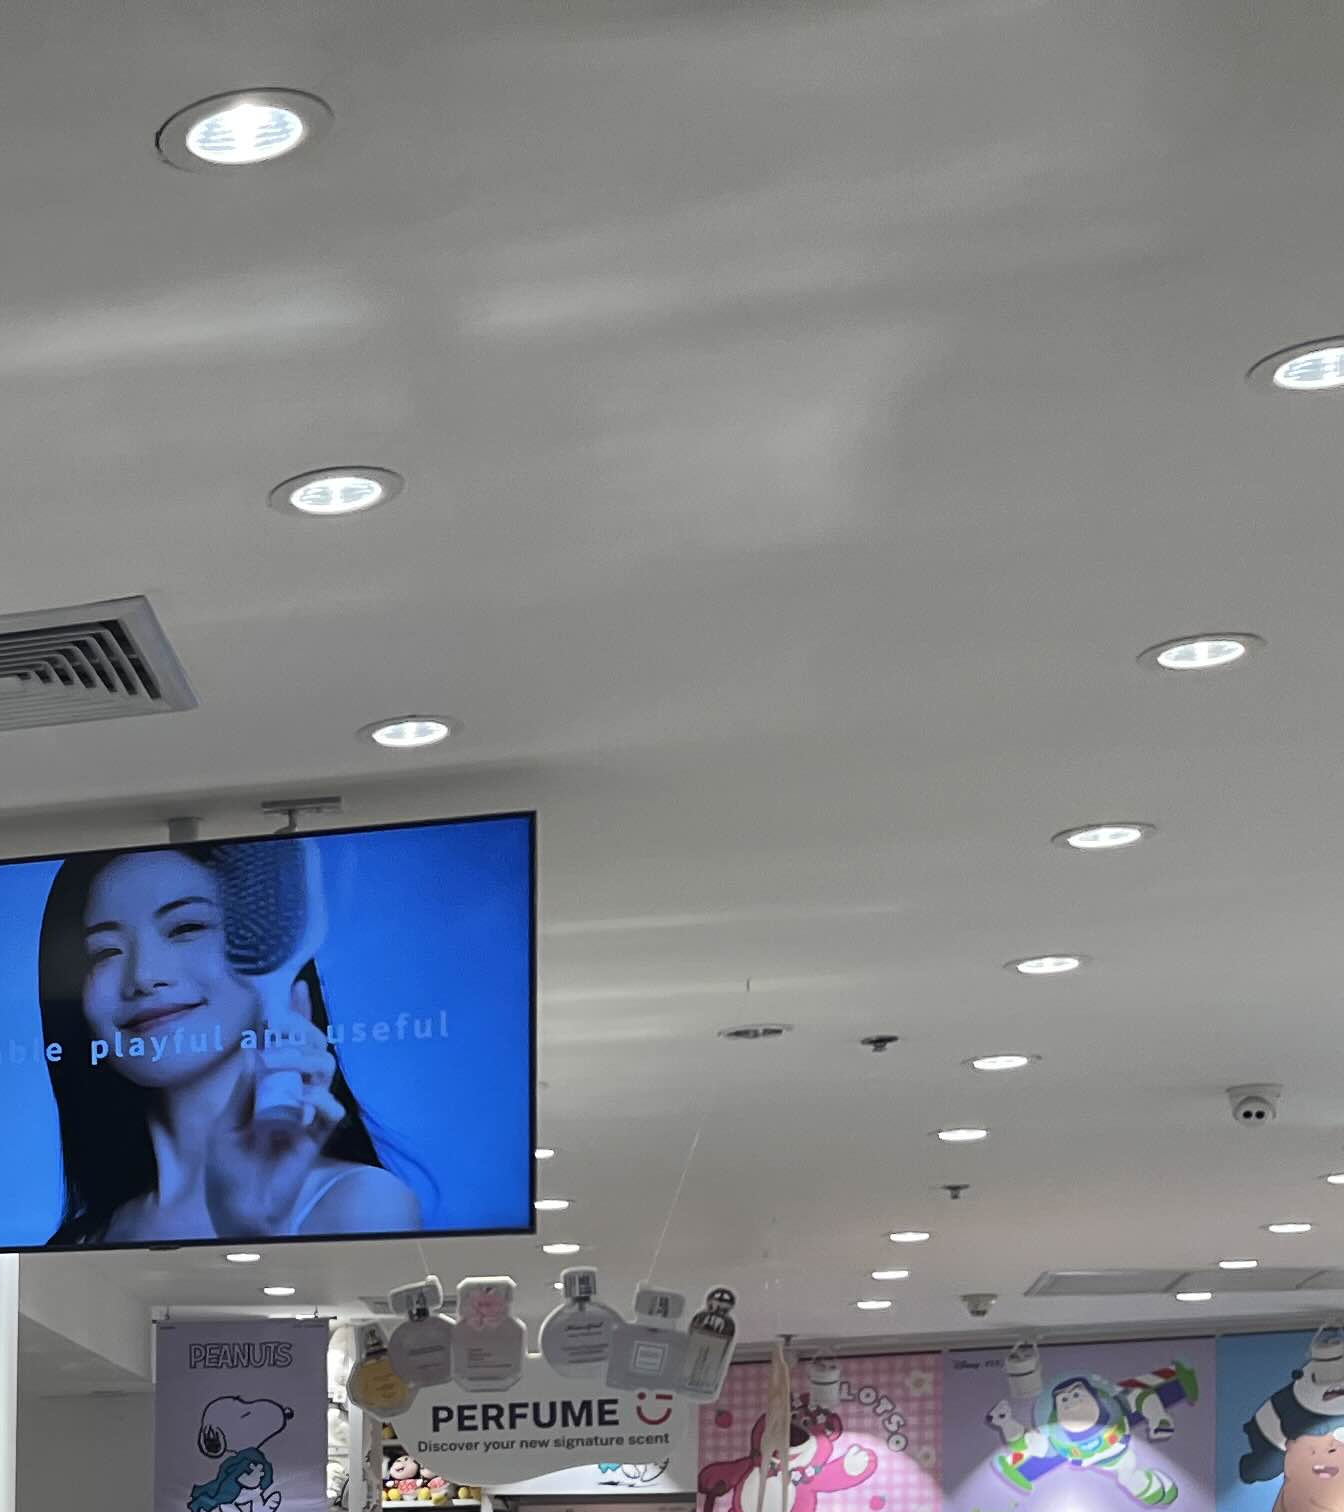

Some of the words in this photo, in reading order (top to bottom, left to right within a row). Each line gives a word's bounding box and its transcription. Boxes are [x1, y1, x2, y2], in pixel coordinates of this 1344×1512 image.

[90, 1027, 225, 1065] playful
[239, 1019, 308, 1051] and
[326, 1011, 450, 1045] useful
[188, 1341, 293, 1370] PEANUTS
[431, 1398, 620, 1432] PERFUME
[839, 1380, 909, 1452] LOTSO
[417, 1437, 482, 1454] Discover
[484, 1438, 516, 1454] your
[519, 1438, 551, 1450] new
[553, 1434, 625, 1453] signature
[627, 1432, 670, 1446] scent
